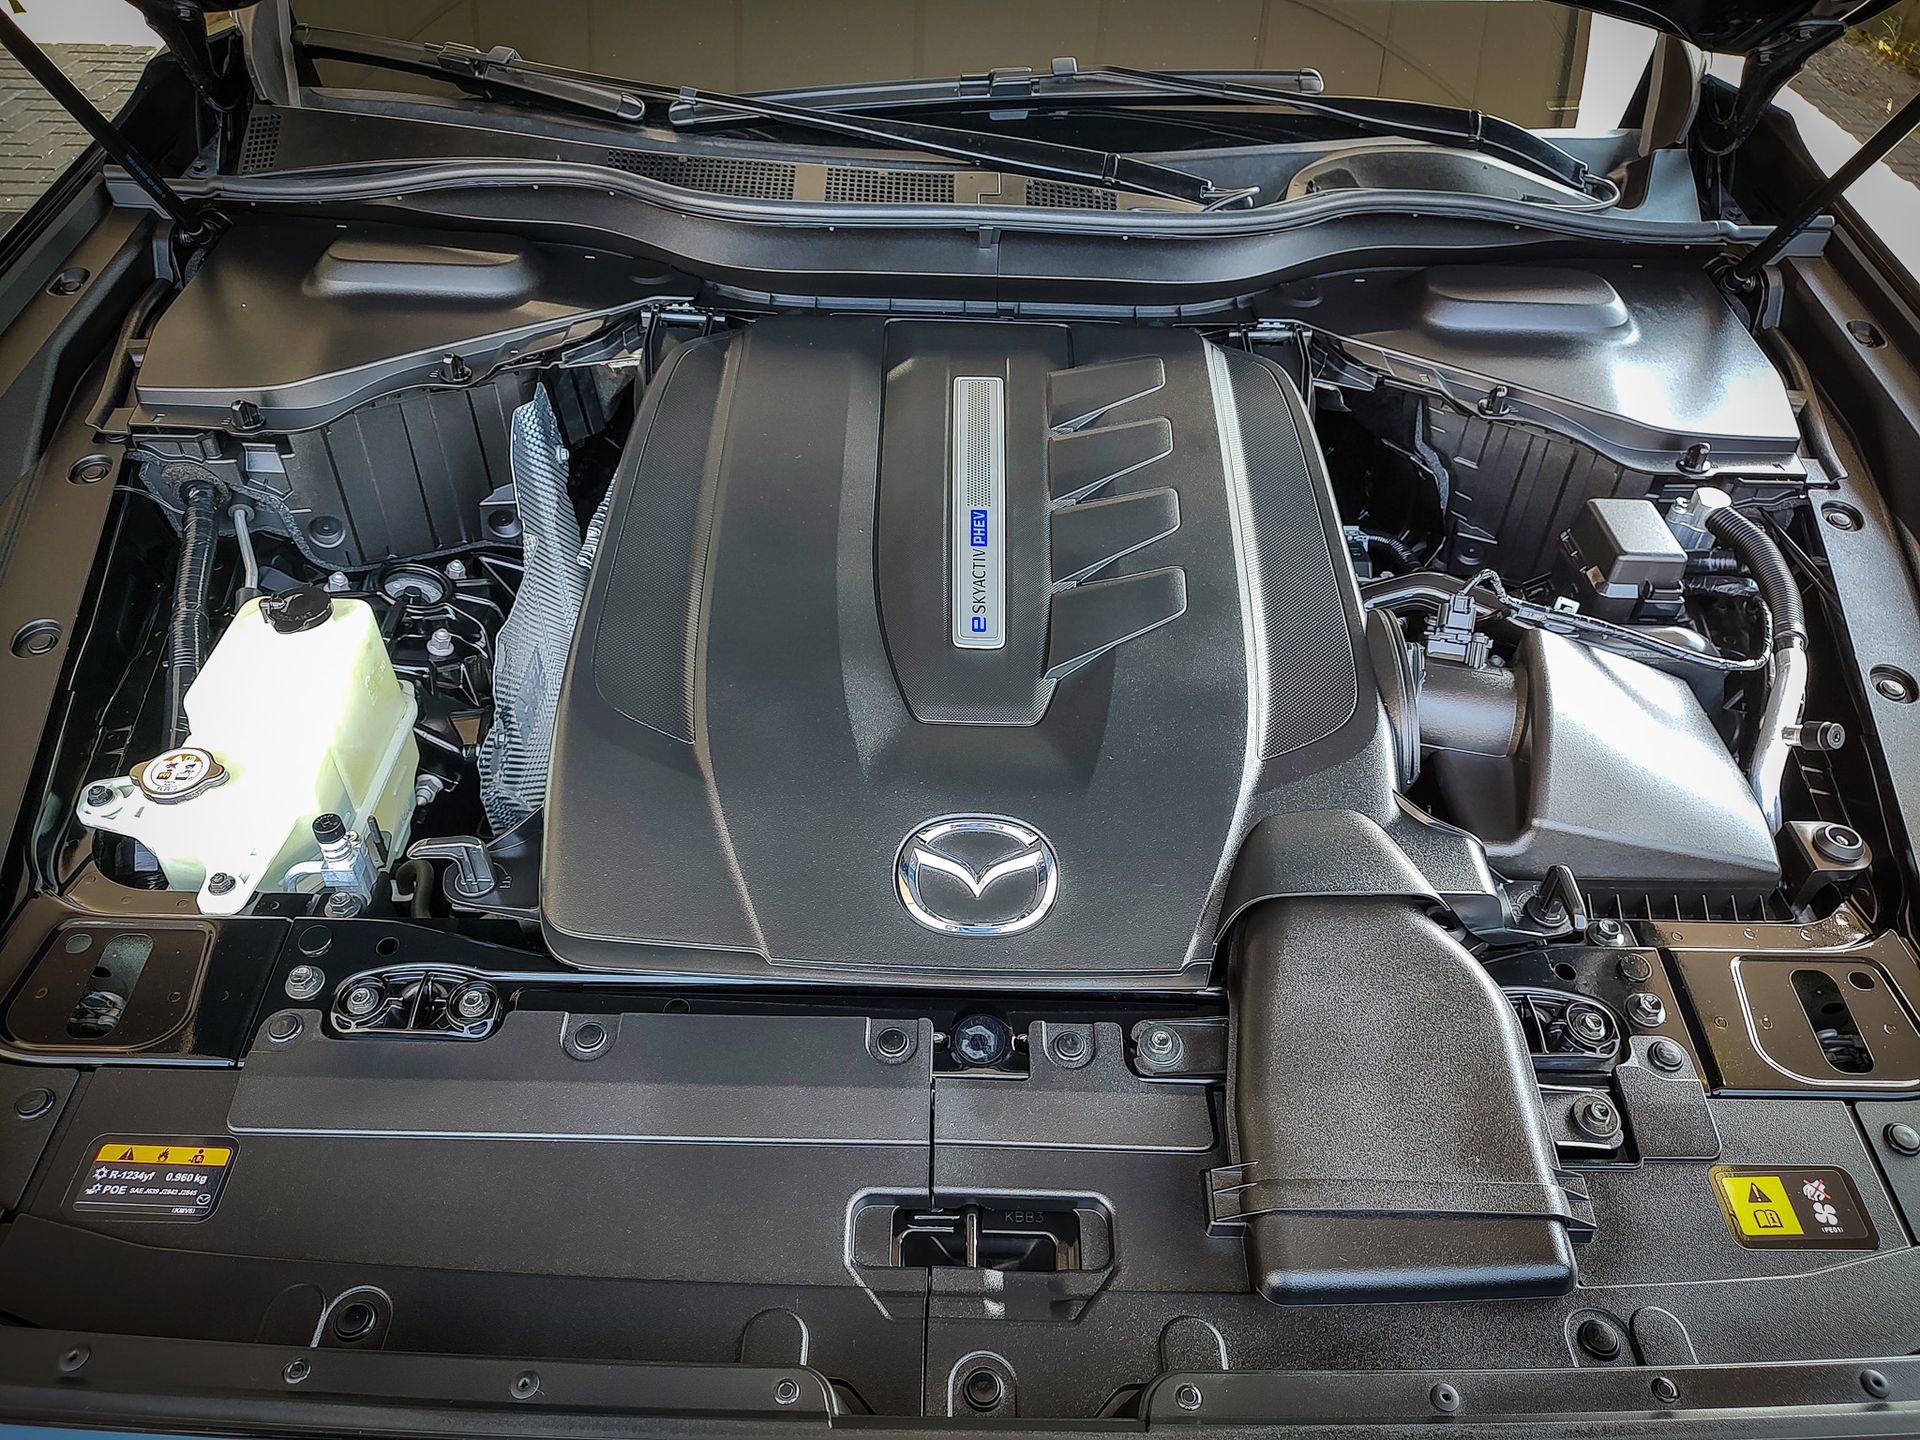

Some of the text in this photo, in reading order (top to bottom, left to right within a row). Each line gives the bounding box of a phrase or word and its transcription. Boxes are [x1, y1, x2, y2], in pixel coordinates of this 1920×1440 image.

[973, 511, 986, 545] PHEV
[972, 548, 986, 614] SKYACTIV
[109, 1170, 208, 1185] R-1234yf 0.960 kg
[102, 1185, 128, 1195] POE
